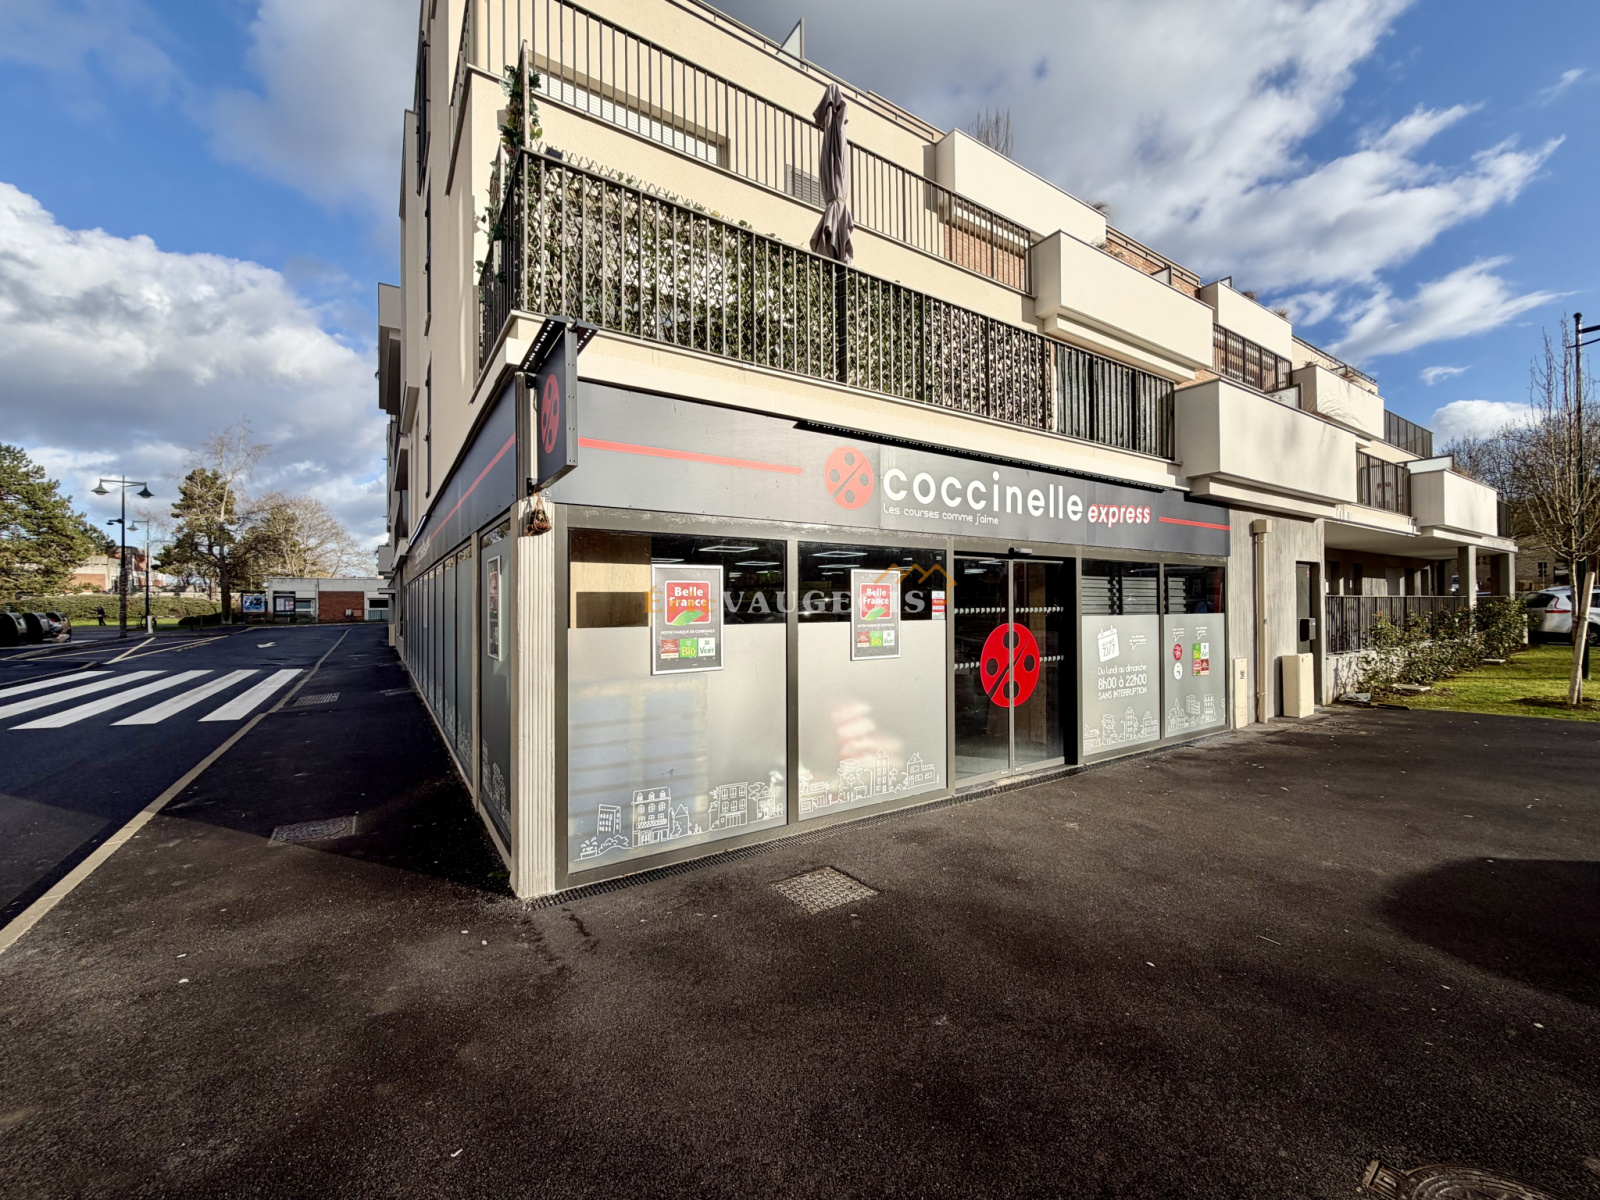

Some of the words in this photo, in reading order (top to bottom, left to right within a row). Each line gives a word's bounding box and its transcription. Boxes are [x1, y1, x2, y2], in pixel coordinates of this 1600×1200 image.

[883, 468, 1083, 521] coccinelle
[1087, 503, 1150, 528] express
[883, 502, 900, 515] Les
[904, 508, 939, 519] courses
[942, 512, 973, 522] comme
[975, 513, 999, 525] j'aime
[674, 586, 703, 597] Belle
[866, 588, 887, 597] Belle
[669, 597, 707, 607] France
[863, 596, 889, 605] France
[1098, 667, 1105, 675] Du
[1106, 665, 1117, 674] lundi
[1126, 662, 1147, 672] dimanche
[1098, 676, 1116, 690] 8h00
[1118, 676, 1124, 687] à
[1126, 673, 1147, 687] 22h00
[1098, 690, 1112, 700] SANS
[1113, 686, 1147, 698] INTERRUPTION
